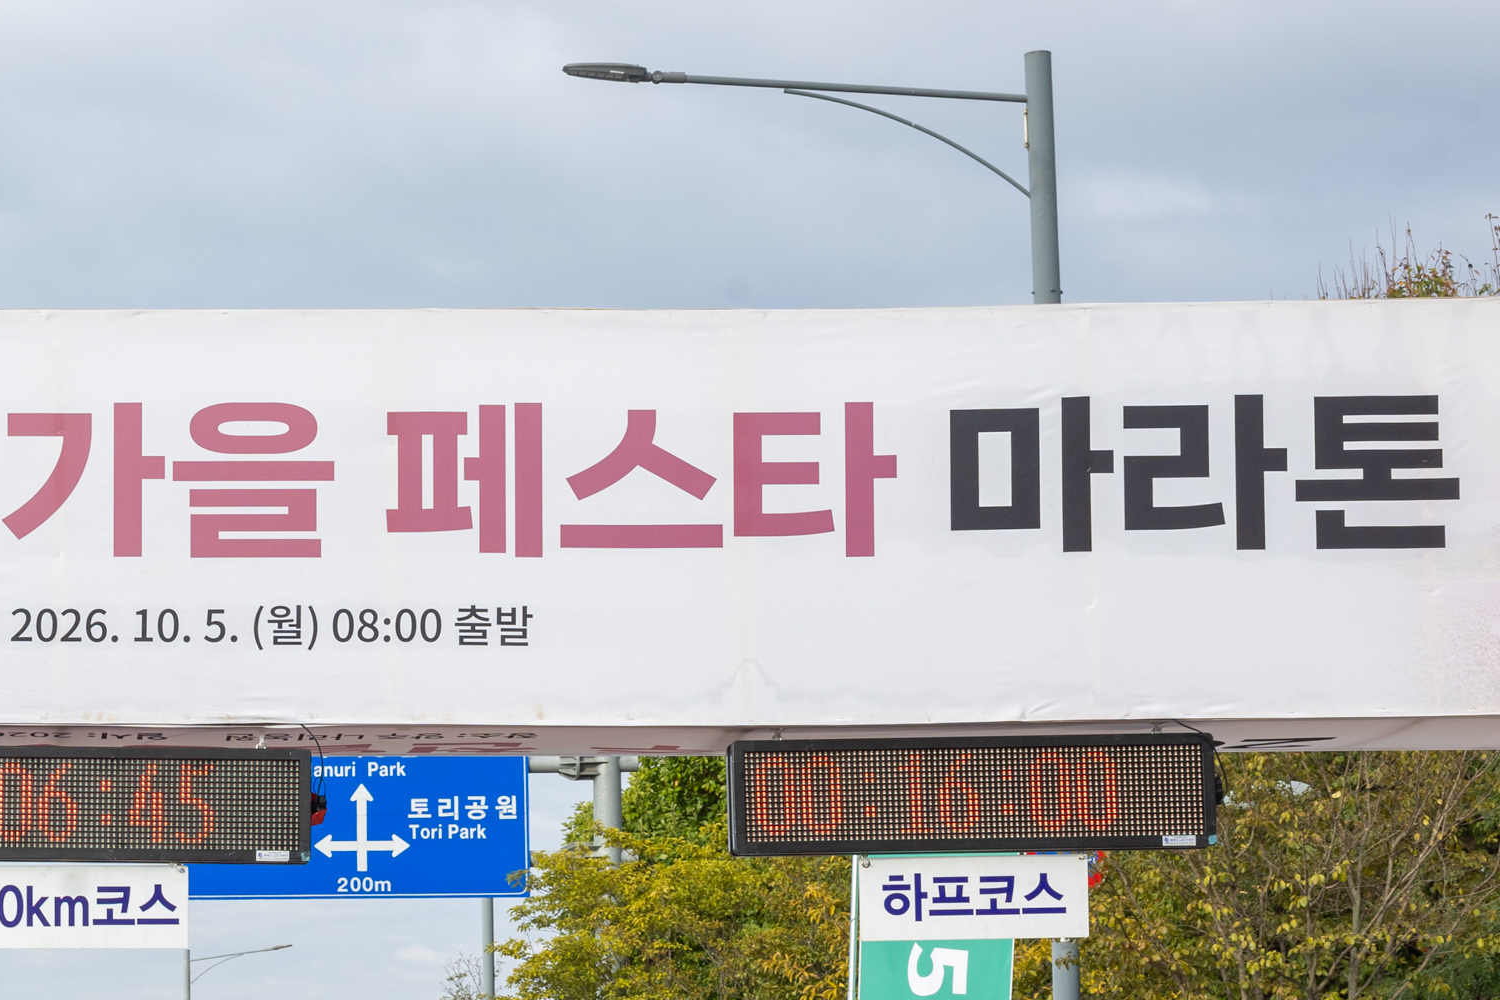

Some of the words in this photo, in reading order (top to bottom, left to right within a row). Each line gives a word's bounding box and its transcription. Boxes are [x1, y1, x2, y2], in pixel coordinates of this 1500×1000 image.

[1, 402, 335, 558] 가을
[386, 401, 897, 558] 페스타
[950, 394, 1460, 553] 마라톤
[11, 608, 118, 643] 2026.
[133, 608, 191, 643] 10.
[204, 608, 238, 643] 5.
[253, 605, 318, 651] (월)
[333, 608, 442, 643] 08:00
[454, 604, 533, 646] 출발
[312, 762, 356, 777] anuri
[366, 762, 407, 777] Park
[407, 795, 518, 820] 토리공원
[755, 751, 1117, 836] 00:16:00
[409, 824, 443, 840] Tori
[449, 824, 487, 840] Park
[337, 877, 392, 893] 200m
[882, 873, 1067, 922] 하프코스
